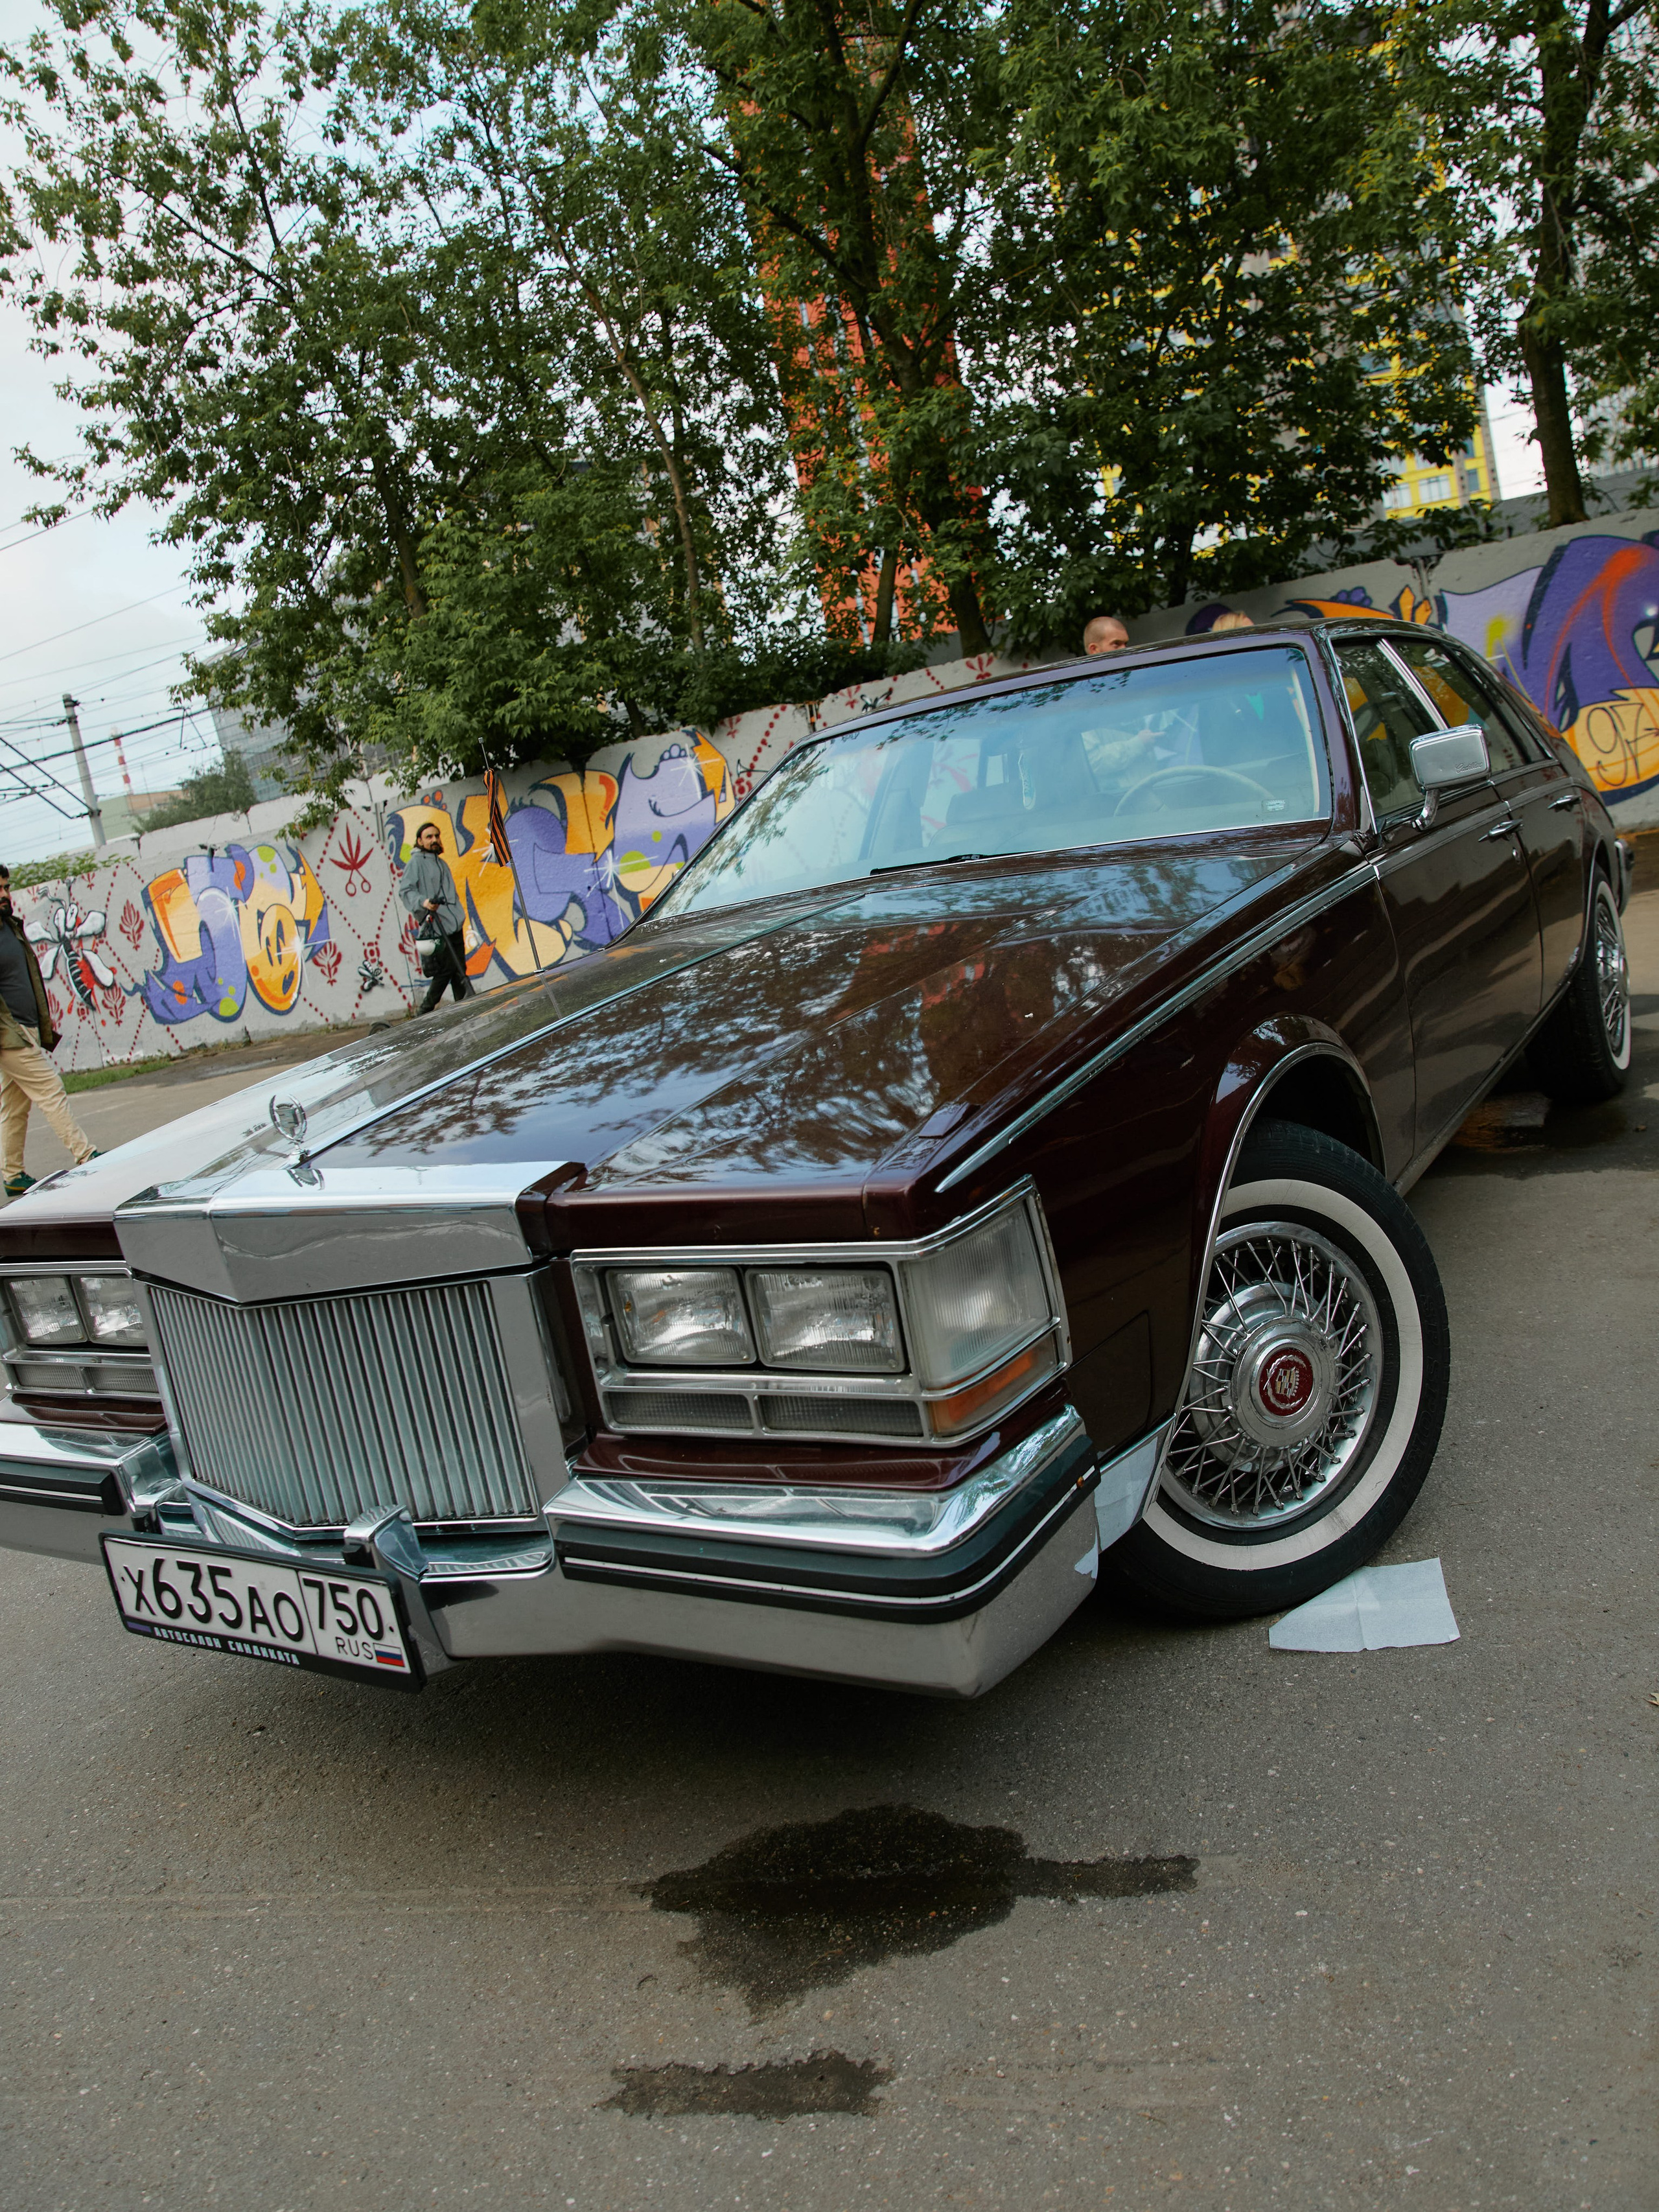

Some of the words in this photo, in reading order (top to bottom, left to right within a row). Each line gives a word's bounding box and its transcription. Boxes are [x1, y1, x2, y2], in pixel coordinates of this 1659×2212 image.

[1421, 1296, 1440, 1345] SP
[1398, 1358, 1441, 1491] SPORT
[303, 1578, 384, 1641] 750
[154, 1627, 222, 1648] АВТОСАЛОН
[228, 1640, 300, 1665] СИНДИКАТА
[336, 1636, 373, 1660] RUS
